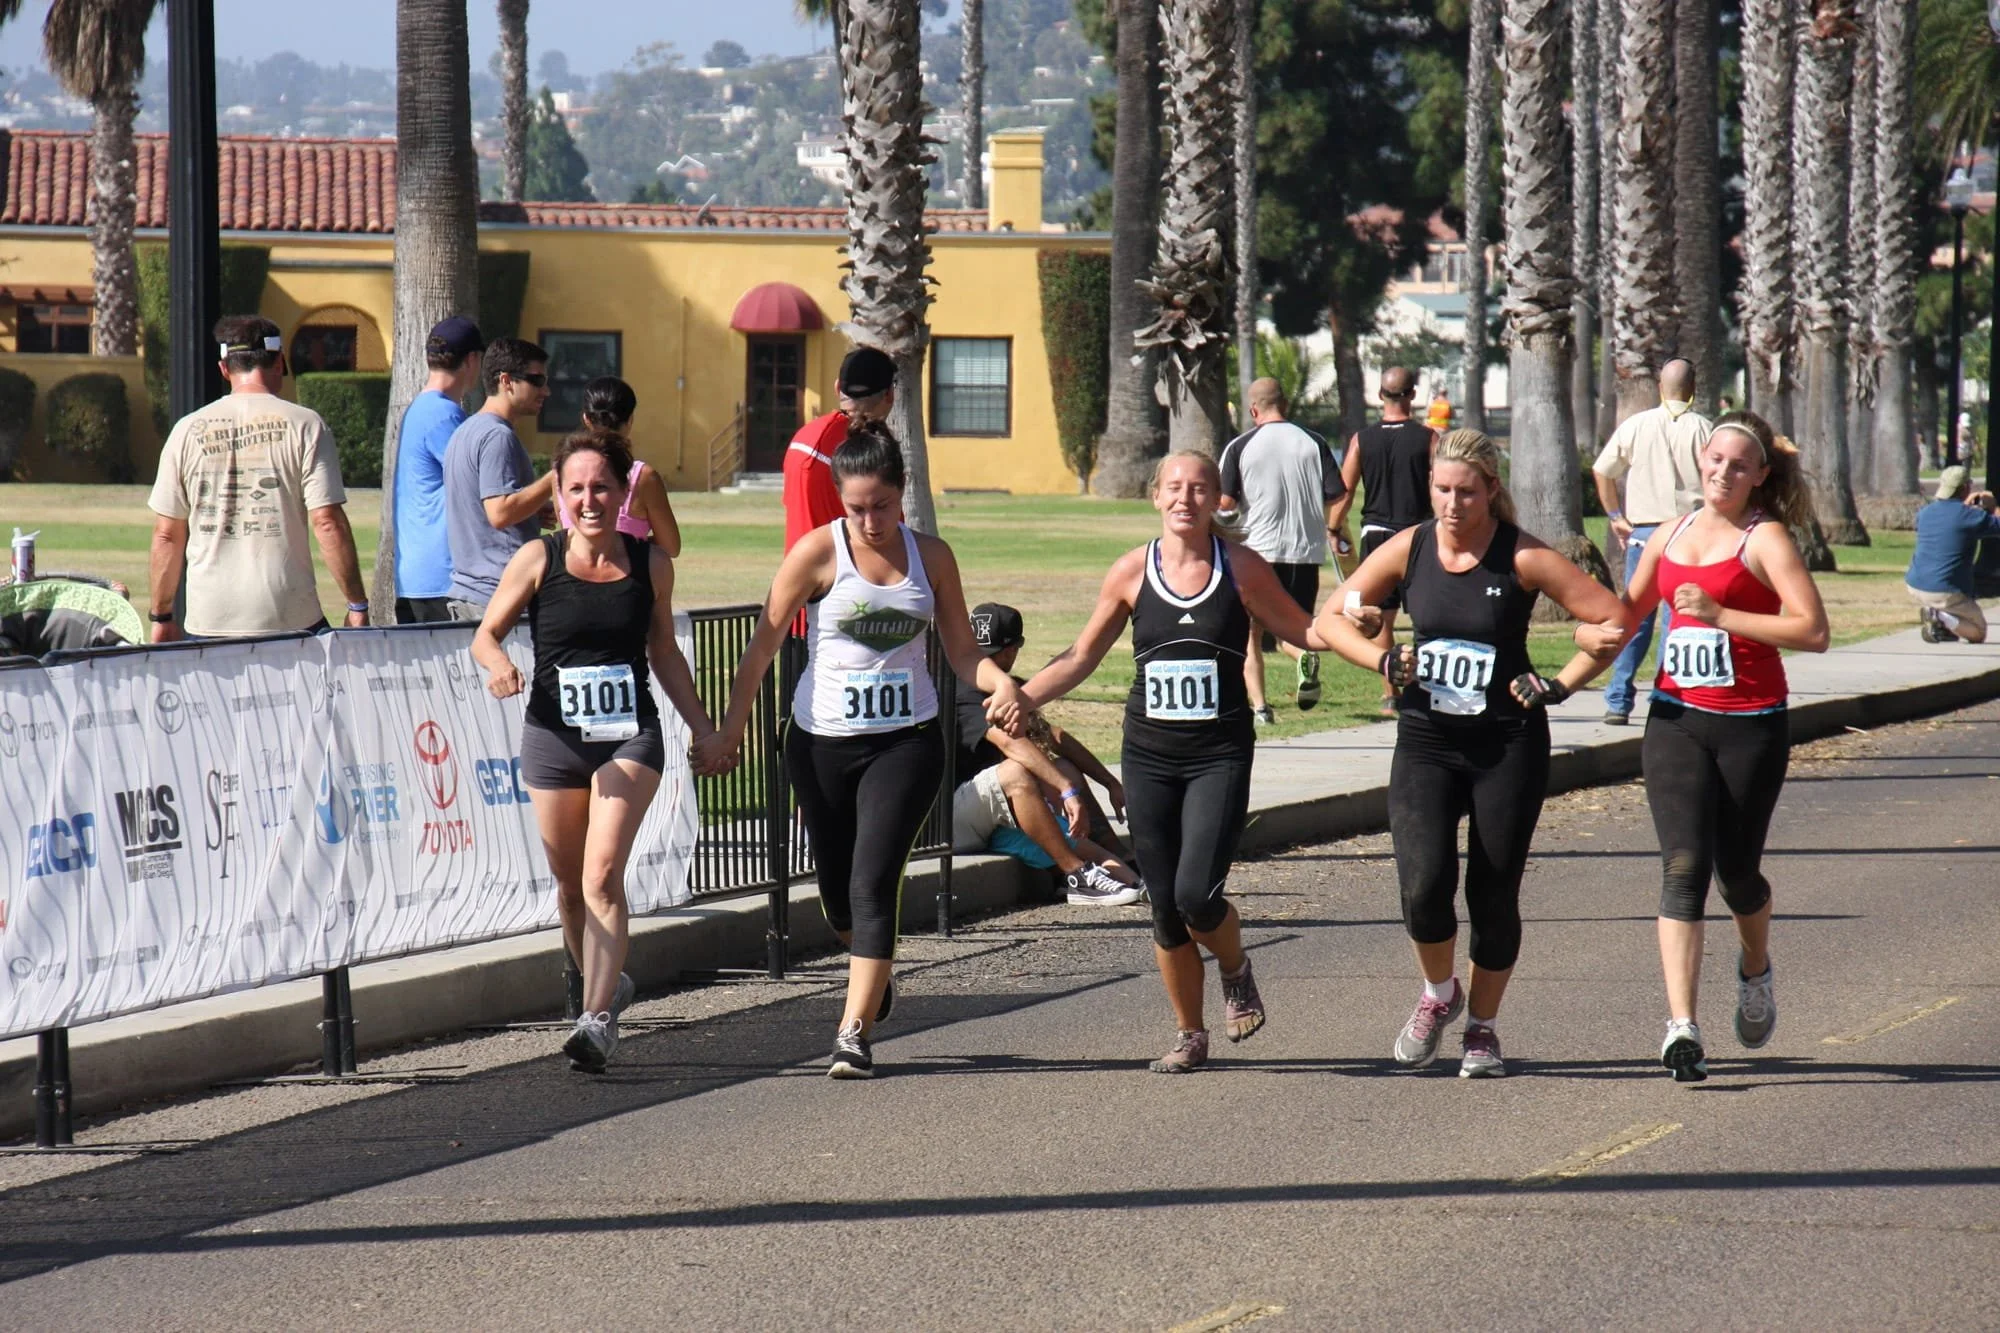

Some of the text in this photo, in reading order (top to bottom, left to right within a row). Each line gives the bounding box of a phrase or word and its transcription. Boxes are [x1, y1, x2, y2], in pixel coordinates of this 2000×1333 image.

[202, 430, 286, 457] YOU PROTECT
[214, 423, 255, 441] BUILD
[257, 420, 288, 433] WHAT
[882, 671, 908, 682] Challenge
[1421, 650, 1488, 692] 3101
[1669, 643, 1729, 677] 3101
[563, 679, 634, 717] 3101
[844, 683, 912, 719] 3101
[1149, 675, 1216, 710] 3101
[421, 819, 474, 855] TOYOTA
